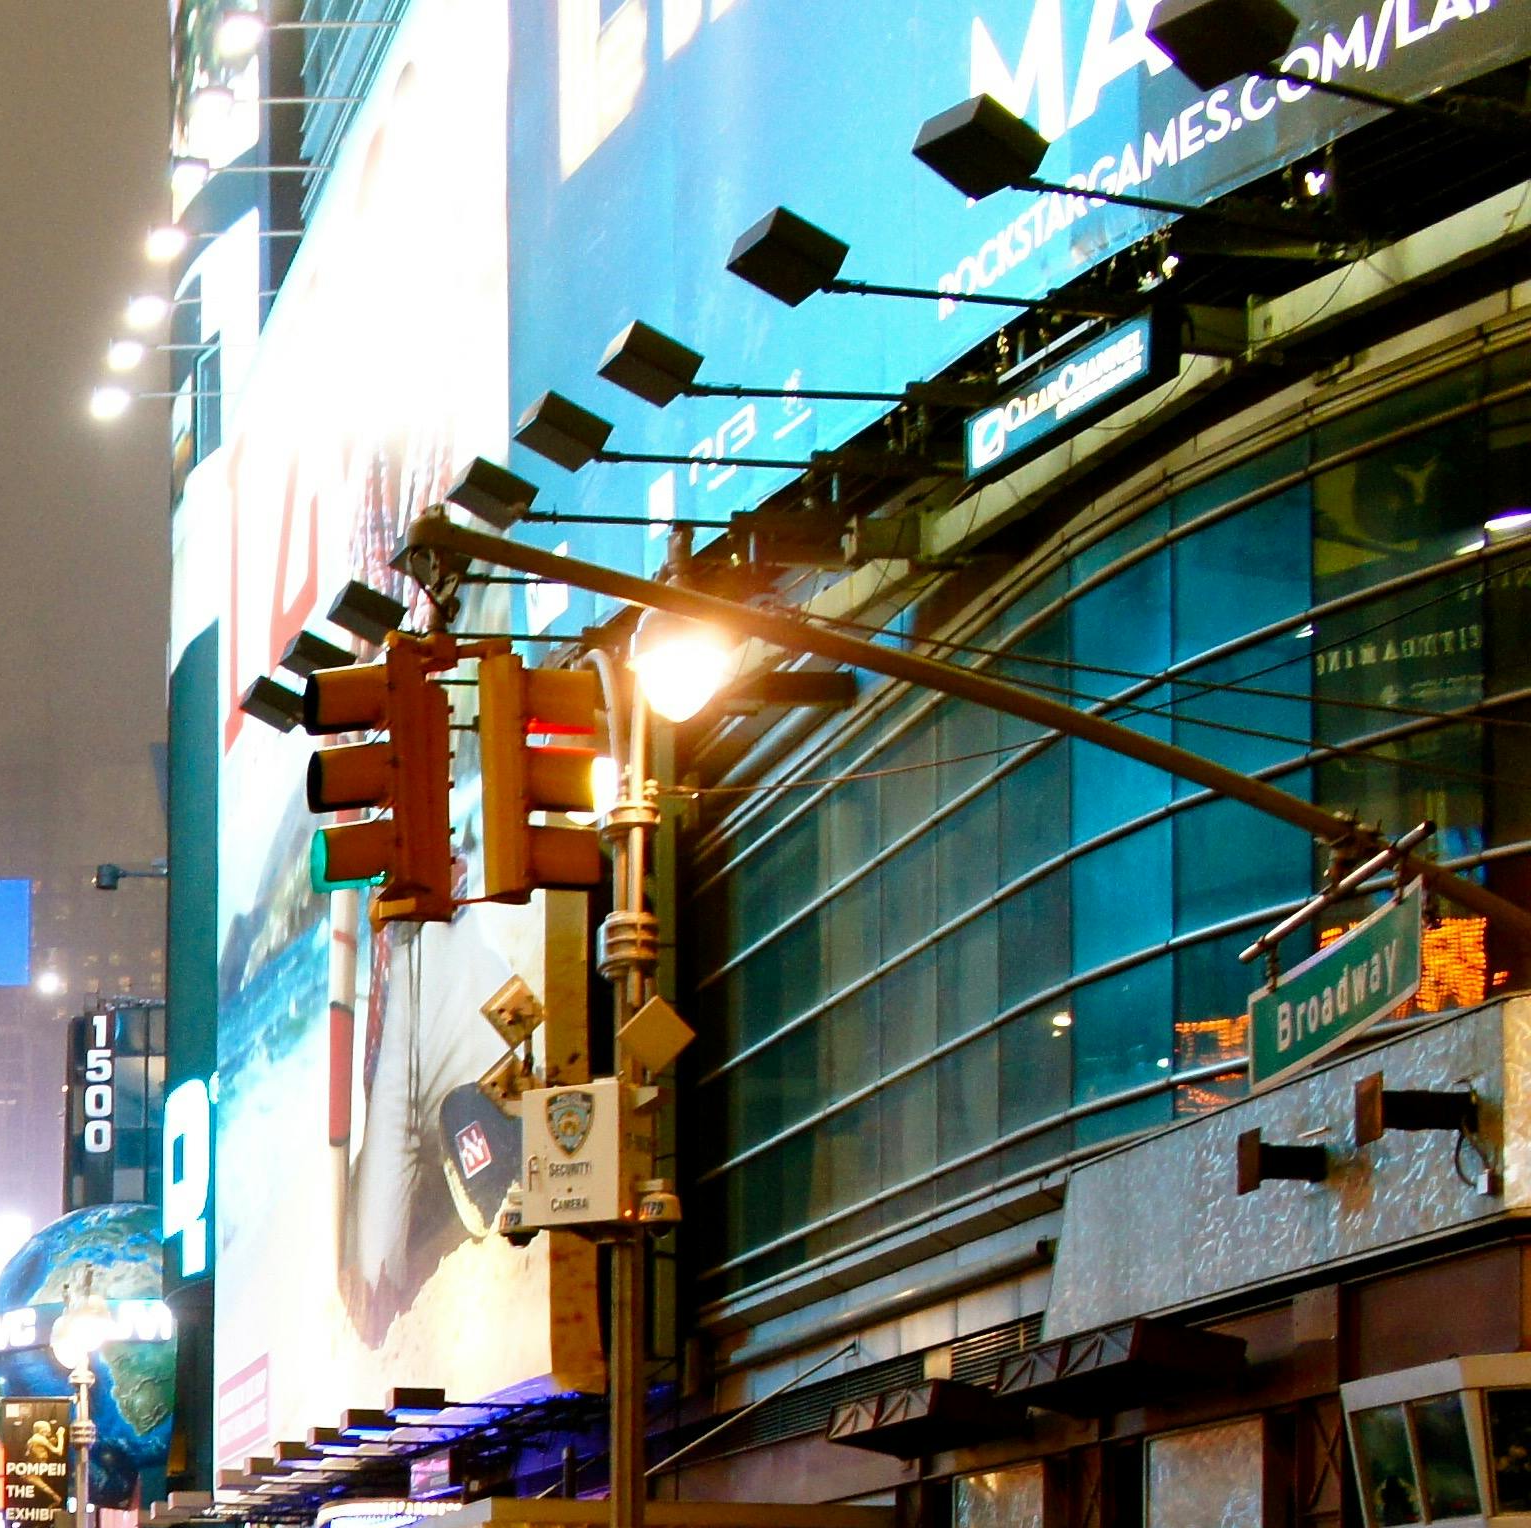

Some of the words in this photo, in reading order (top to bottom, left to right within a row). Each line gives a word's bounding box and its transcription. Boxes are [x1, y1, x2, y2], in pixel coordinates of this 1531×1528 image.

[1276, 938, 1400, 1053] Broadway
[83, 1014, 113, 1153] 1500
[549, 1161, 592, 1179] SECURITY
[550, 1197, 589, 1214] CAMERA
[5, 1462, 67, 1477] POMPEII
[5, 1484, 35, 1499] THE
